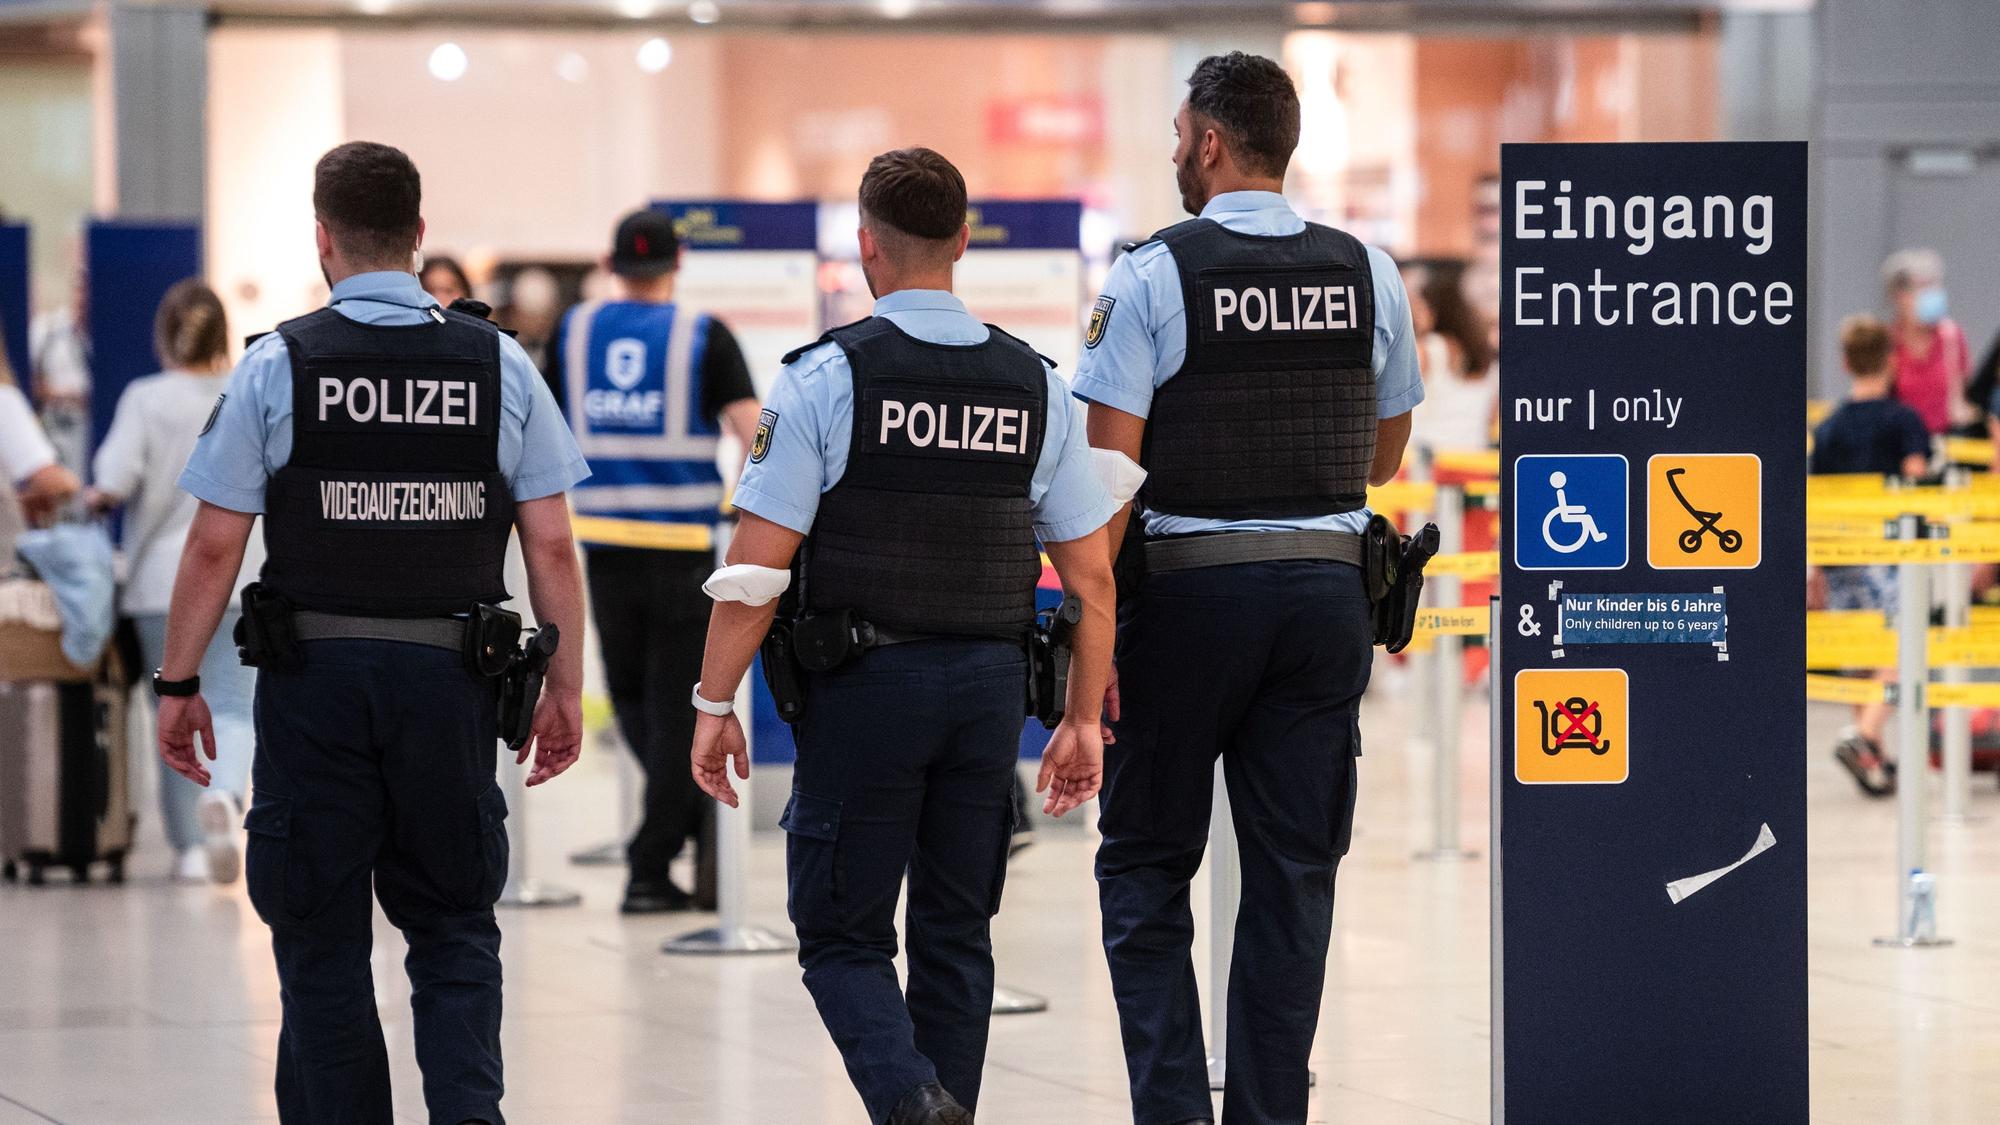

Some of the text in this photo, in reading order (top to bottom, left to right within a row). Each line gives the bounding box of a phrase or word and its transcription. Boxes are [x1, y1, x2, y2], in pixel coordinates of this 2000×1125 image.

[1515, 180, 1773, 255] Eingang
[1214, 286, 1358, 332] POLIZEI
[1515, 267, 1794, 326] Entrance
[318, 377, 477, 426] POLIZEI
[1514, 397, 1573, 422] nur
[1612, 388, 1683, 429] only
[880, 399, 1029, 455] POLIZEI
[320, 480, 486, 521] VIDEOAUFZEICHNUNG
[1517, 603, 1542, 637] &
[1565, 618, 1591, 631] Only
[1594, 618, 1641, 630] children
[1644, 621, 1659, 632] up
[1662, 620, 1674, 630] to
[1677, 619, 1685, 630] 6
[1687, 622, 1718, 632] years
[1566, 598, 1722, 613] Nur Kinder bis 6 Jahre
